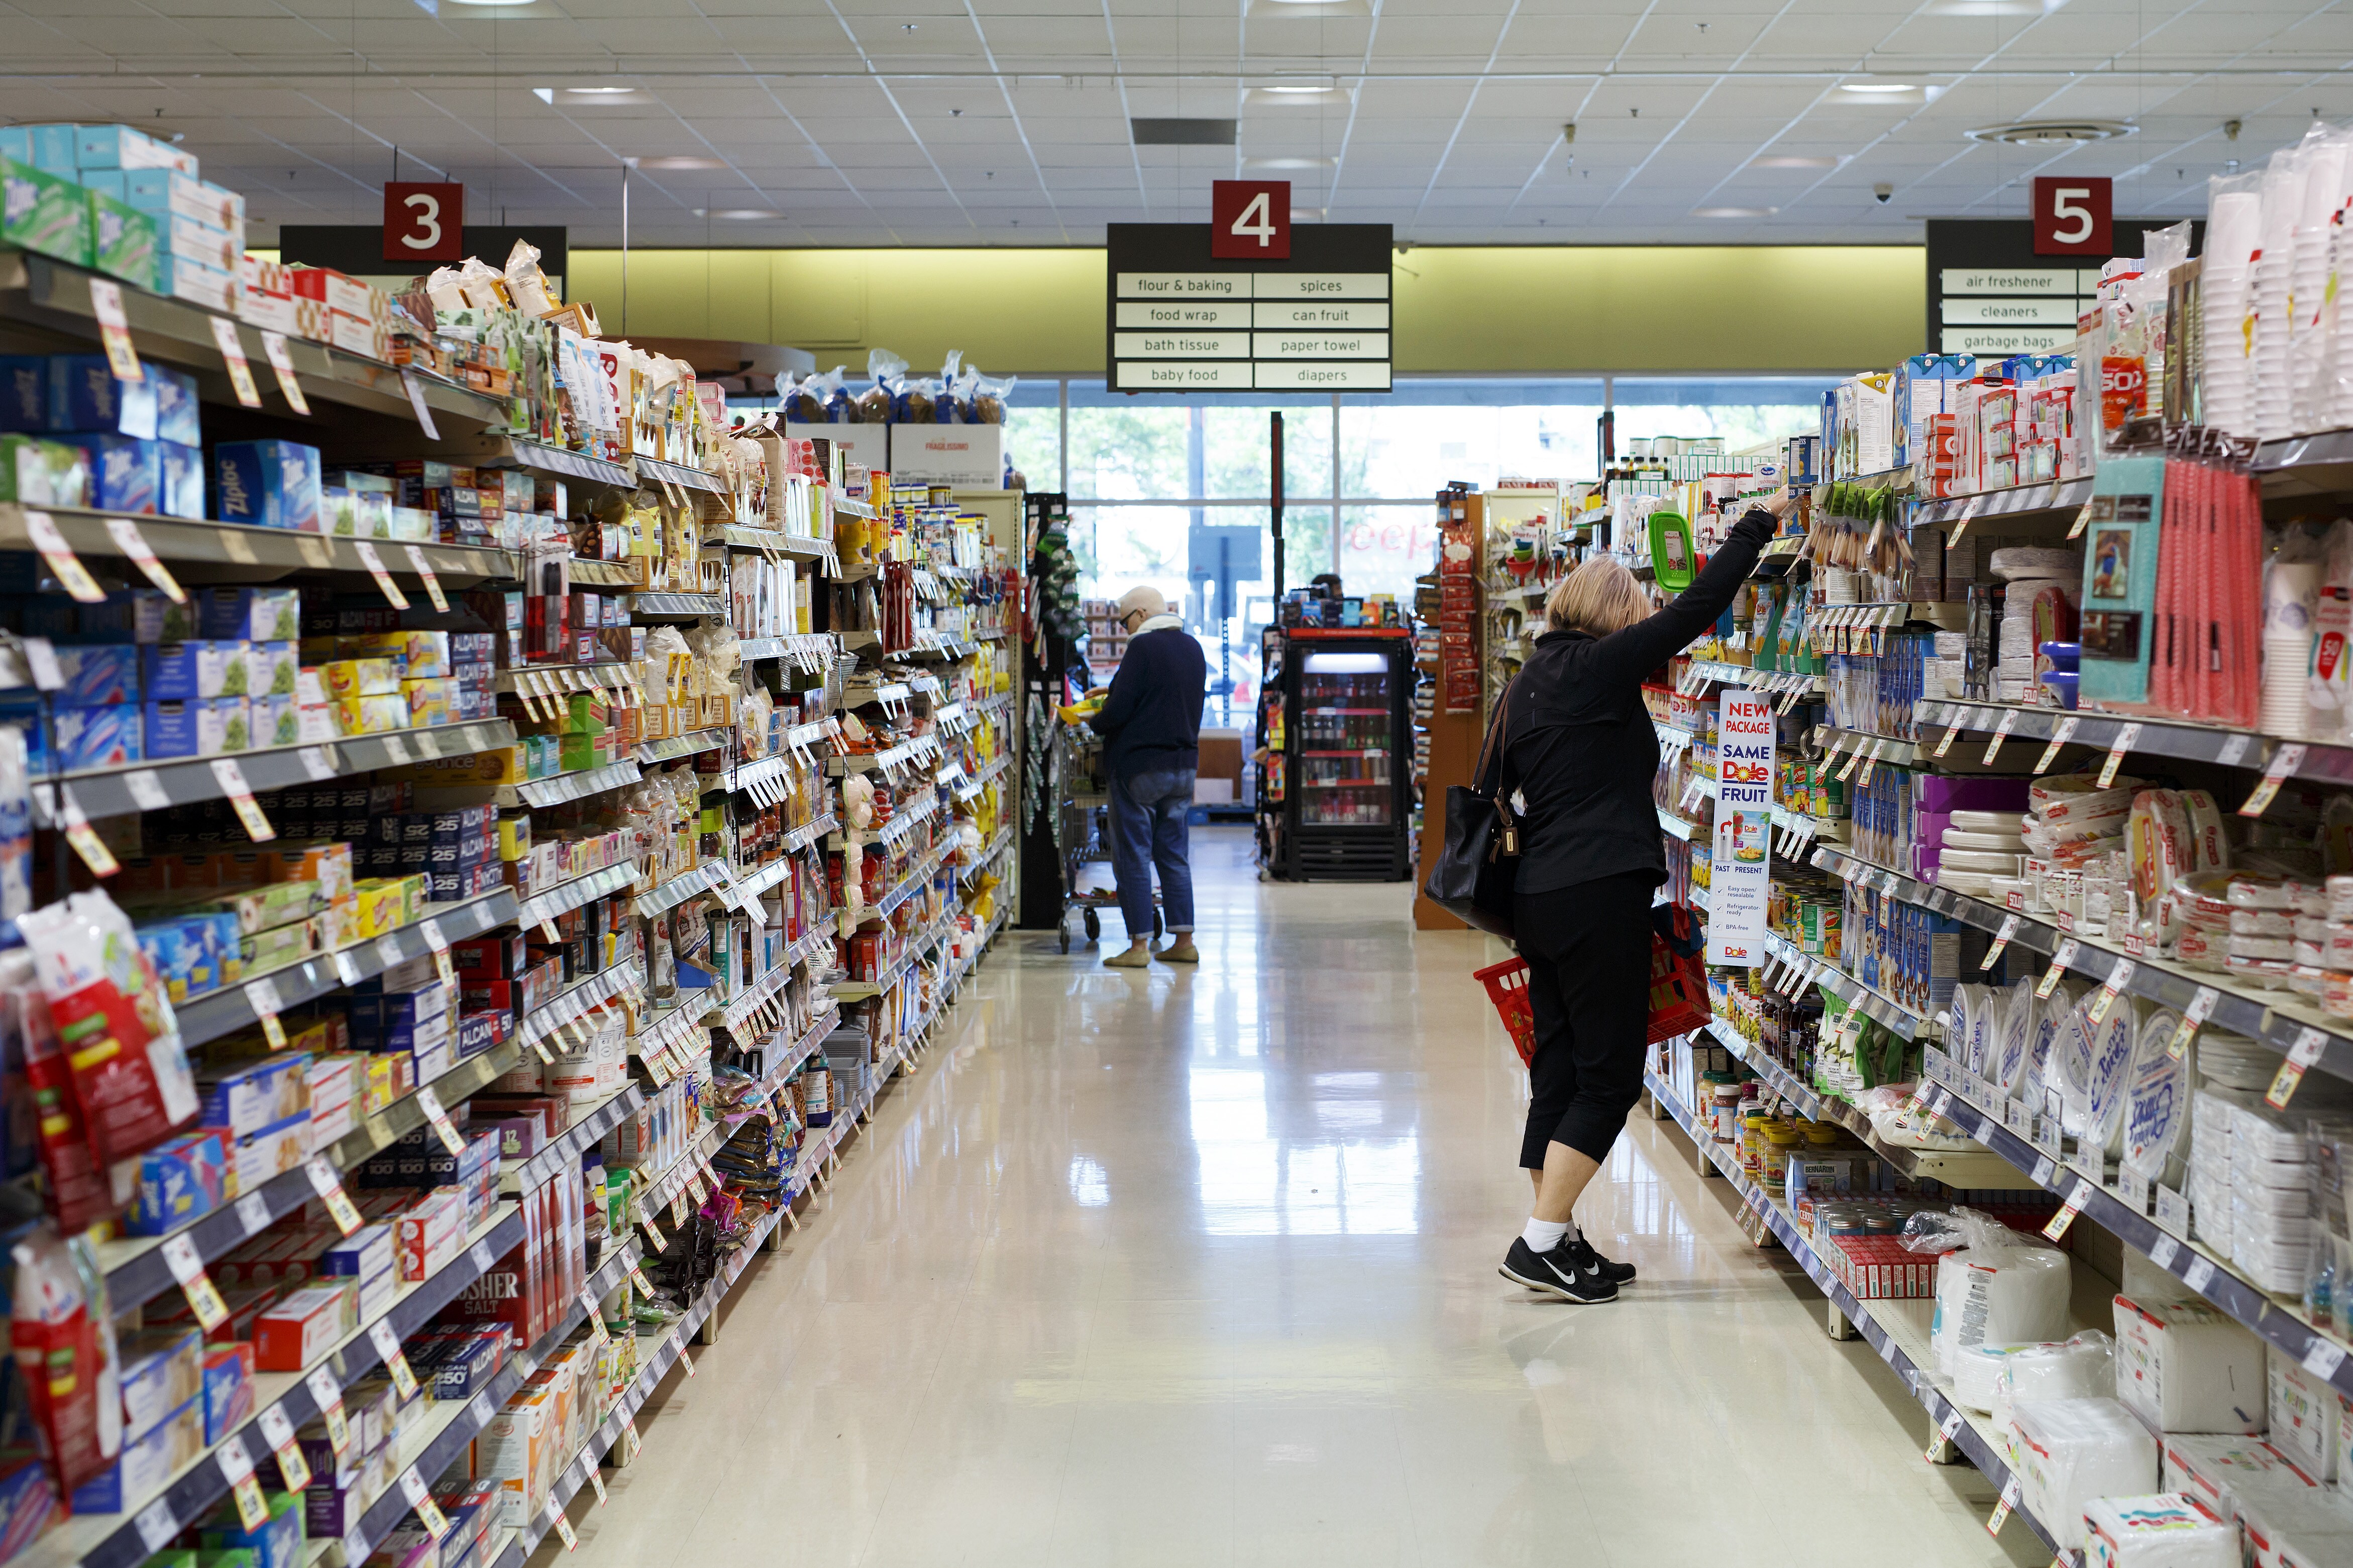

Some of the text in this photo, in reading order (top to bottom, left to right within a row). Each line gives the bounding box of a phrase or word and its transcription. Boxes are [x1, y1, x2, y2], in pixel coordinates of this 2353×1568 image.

[401, 193, 441, 249] 3
[1231, 193, 1276, 247] 4
[2053, 188, 2093, 244] 5
[1138, 280, 1232, 293] flour & baking
[1301, 280, 1342, 293] spices
[1966, 275, 2053, 288] air freshener
[1151, 309, 1217, 323] food wrap
[1293, 309, 1349, 321] can fruit
[1981, 305, 2038, 318] cleaners
[1145, 339, 1219, 351] bath tissue
[1281, 340, 1360, 354] paper towel
[1965, 335, 2055, 351] garbage bags
[1152, 370, 1218, 382] baby food
[1298, 370, 1347, 382] diapers
[221, 460, 249, 516] Ziploc
[1512, 531, 1536, 539] Starfrit
[1729, 702, 1770, 718] NEW
[1726, 720, 1770, 734] PACKAGE
[1723, 744, 1770, 760] SAME
[1722, 760, 1769, 781] Dole
[1721, 787, 1767, 803] FRUIT
[434, 818, 459, 831] 25
[1744, 825, 1758, 833] Dole
[432, 849, 458, 862] 25
[1735, 866, 1762, 874] PRESENT
[434, 877, 459, 890] 25
[1725, 946, 1747, 956] Dole
[462, 1014, 512, 1048] ALCAN 50
[504, 1130, 517, 1142] 12
[399, 1162, 424, 1174] 100
[429, 1161, 455, 1173] 100
[1805, 1165, 1835, 1174] BERNARDIN
[1799, 1210, 1813, 1223] CERTO
[455, 1273, 519, 1302] OSHER
[465, 1300, 498, 1315] SALT
[470, 1348, 496, 1377] ALCAN
